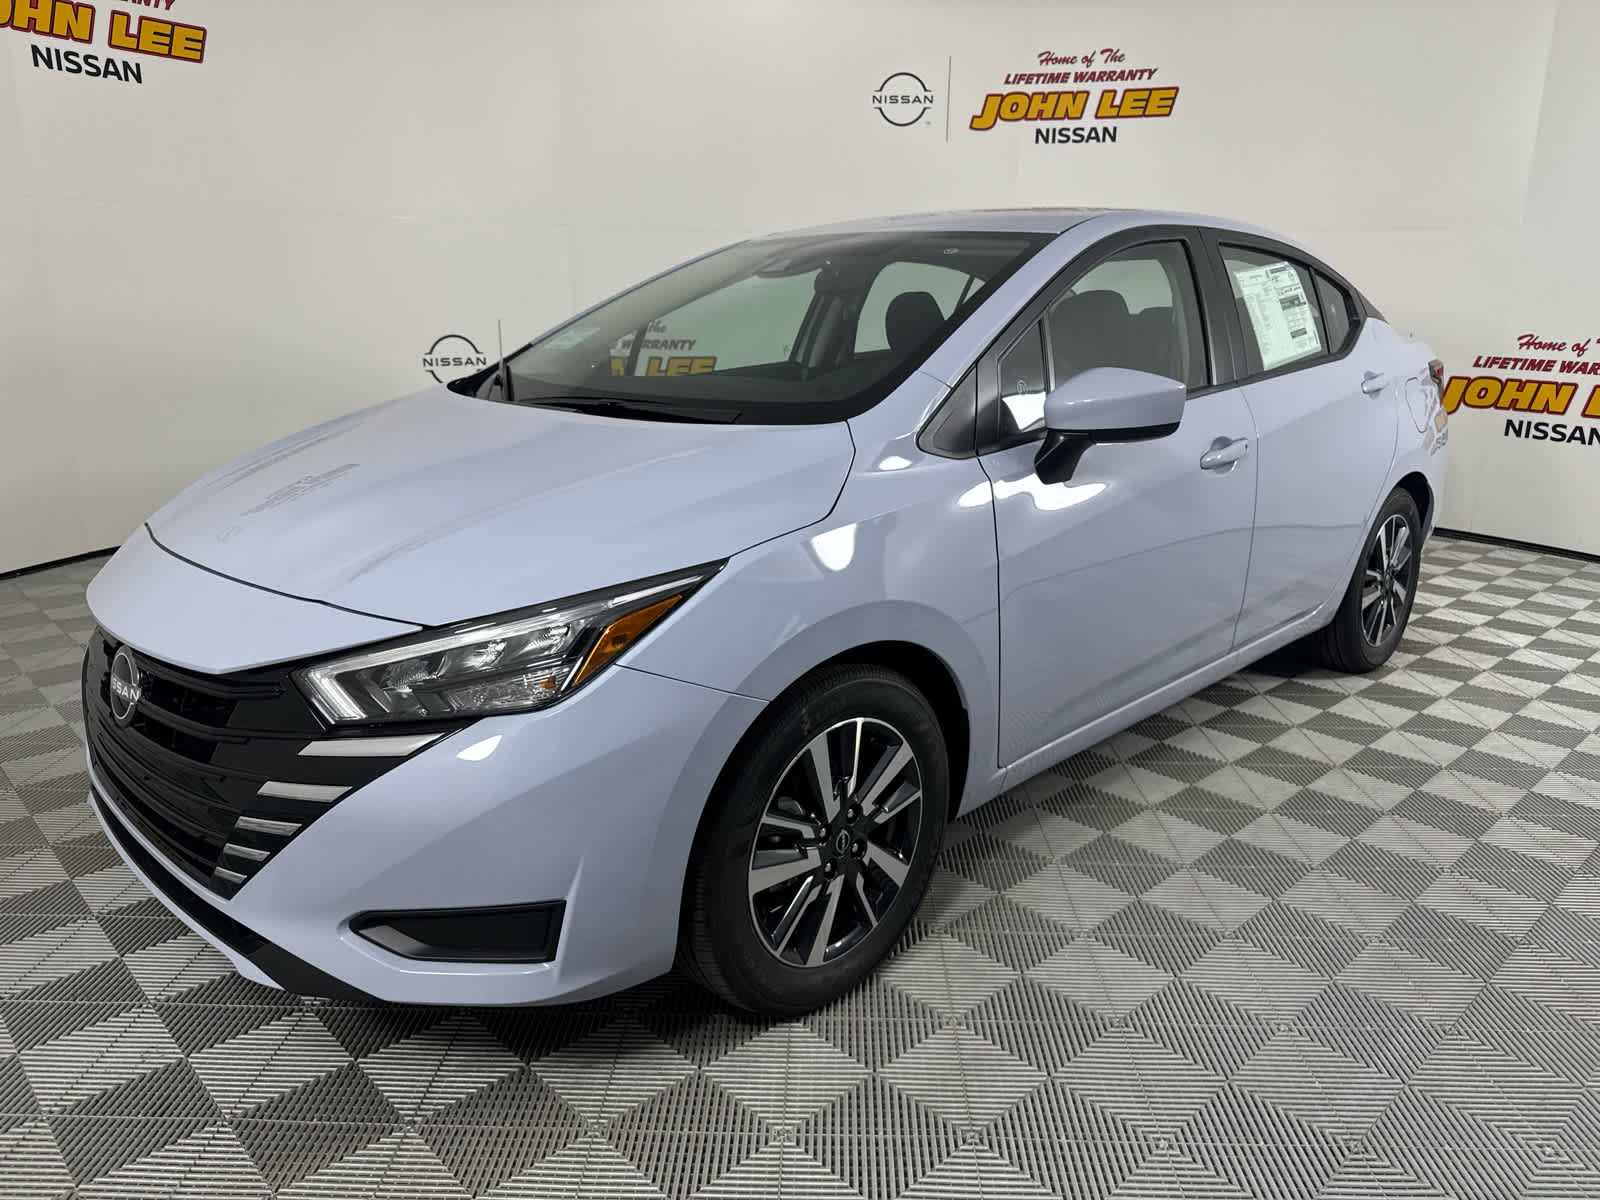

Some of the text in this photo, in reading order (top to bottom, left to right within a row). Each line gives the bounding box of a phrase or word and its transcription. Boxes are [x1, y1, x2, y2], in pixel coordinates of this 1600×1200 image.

[108, 10, 207, 64] LEE
[31, 44, 142, 83] NISSAN
[1037, 48, 1126, 68] Home of The
[1004, 68, 1158, 85] LIFETIME WARRANTY
[872, 95, 934, 104] NISSAN
[969, 87, 1179, 131] JOHN LEE
[1035, 126, 1117, 144] NISSAN
[620, 339, 697, 351] WRRANTY
[1517, 333, 1591, 357] Home of
[423, 357, 487, 368] NISSAN
[1472, 356, 1557, 373] LIFETIME
[1441, 376, 1579, 416] JOHN
[1504, 419, 1600, 446] NISSAN
